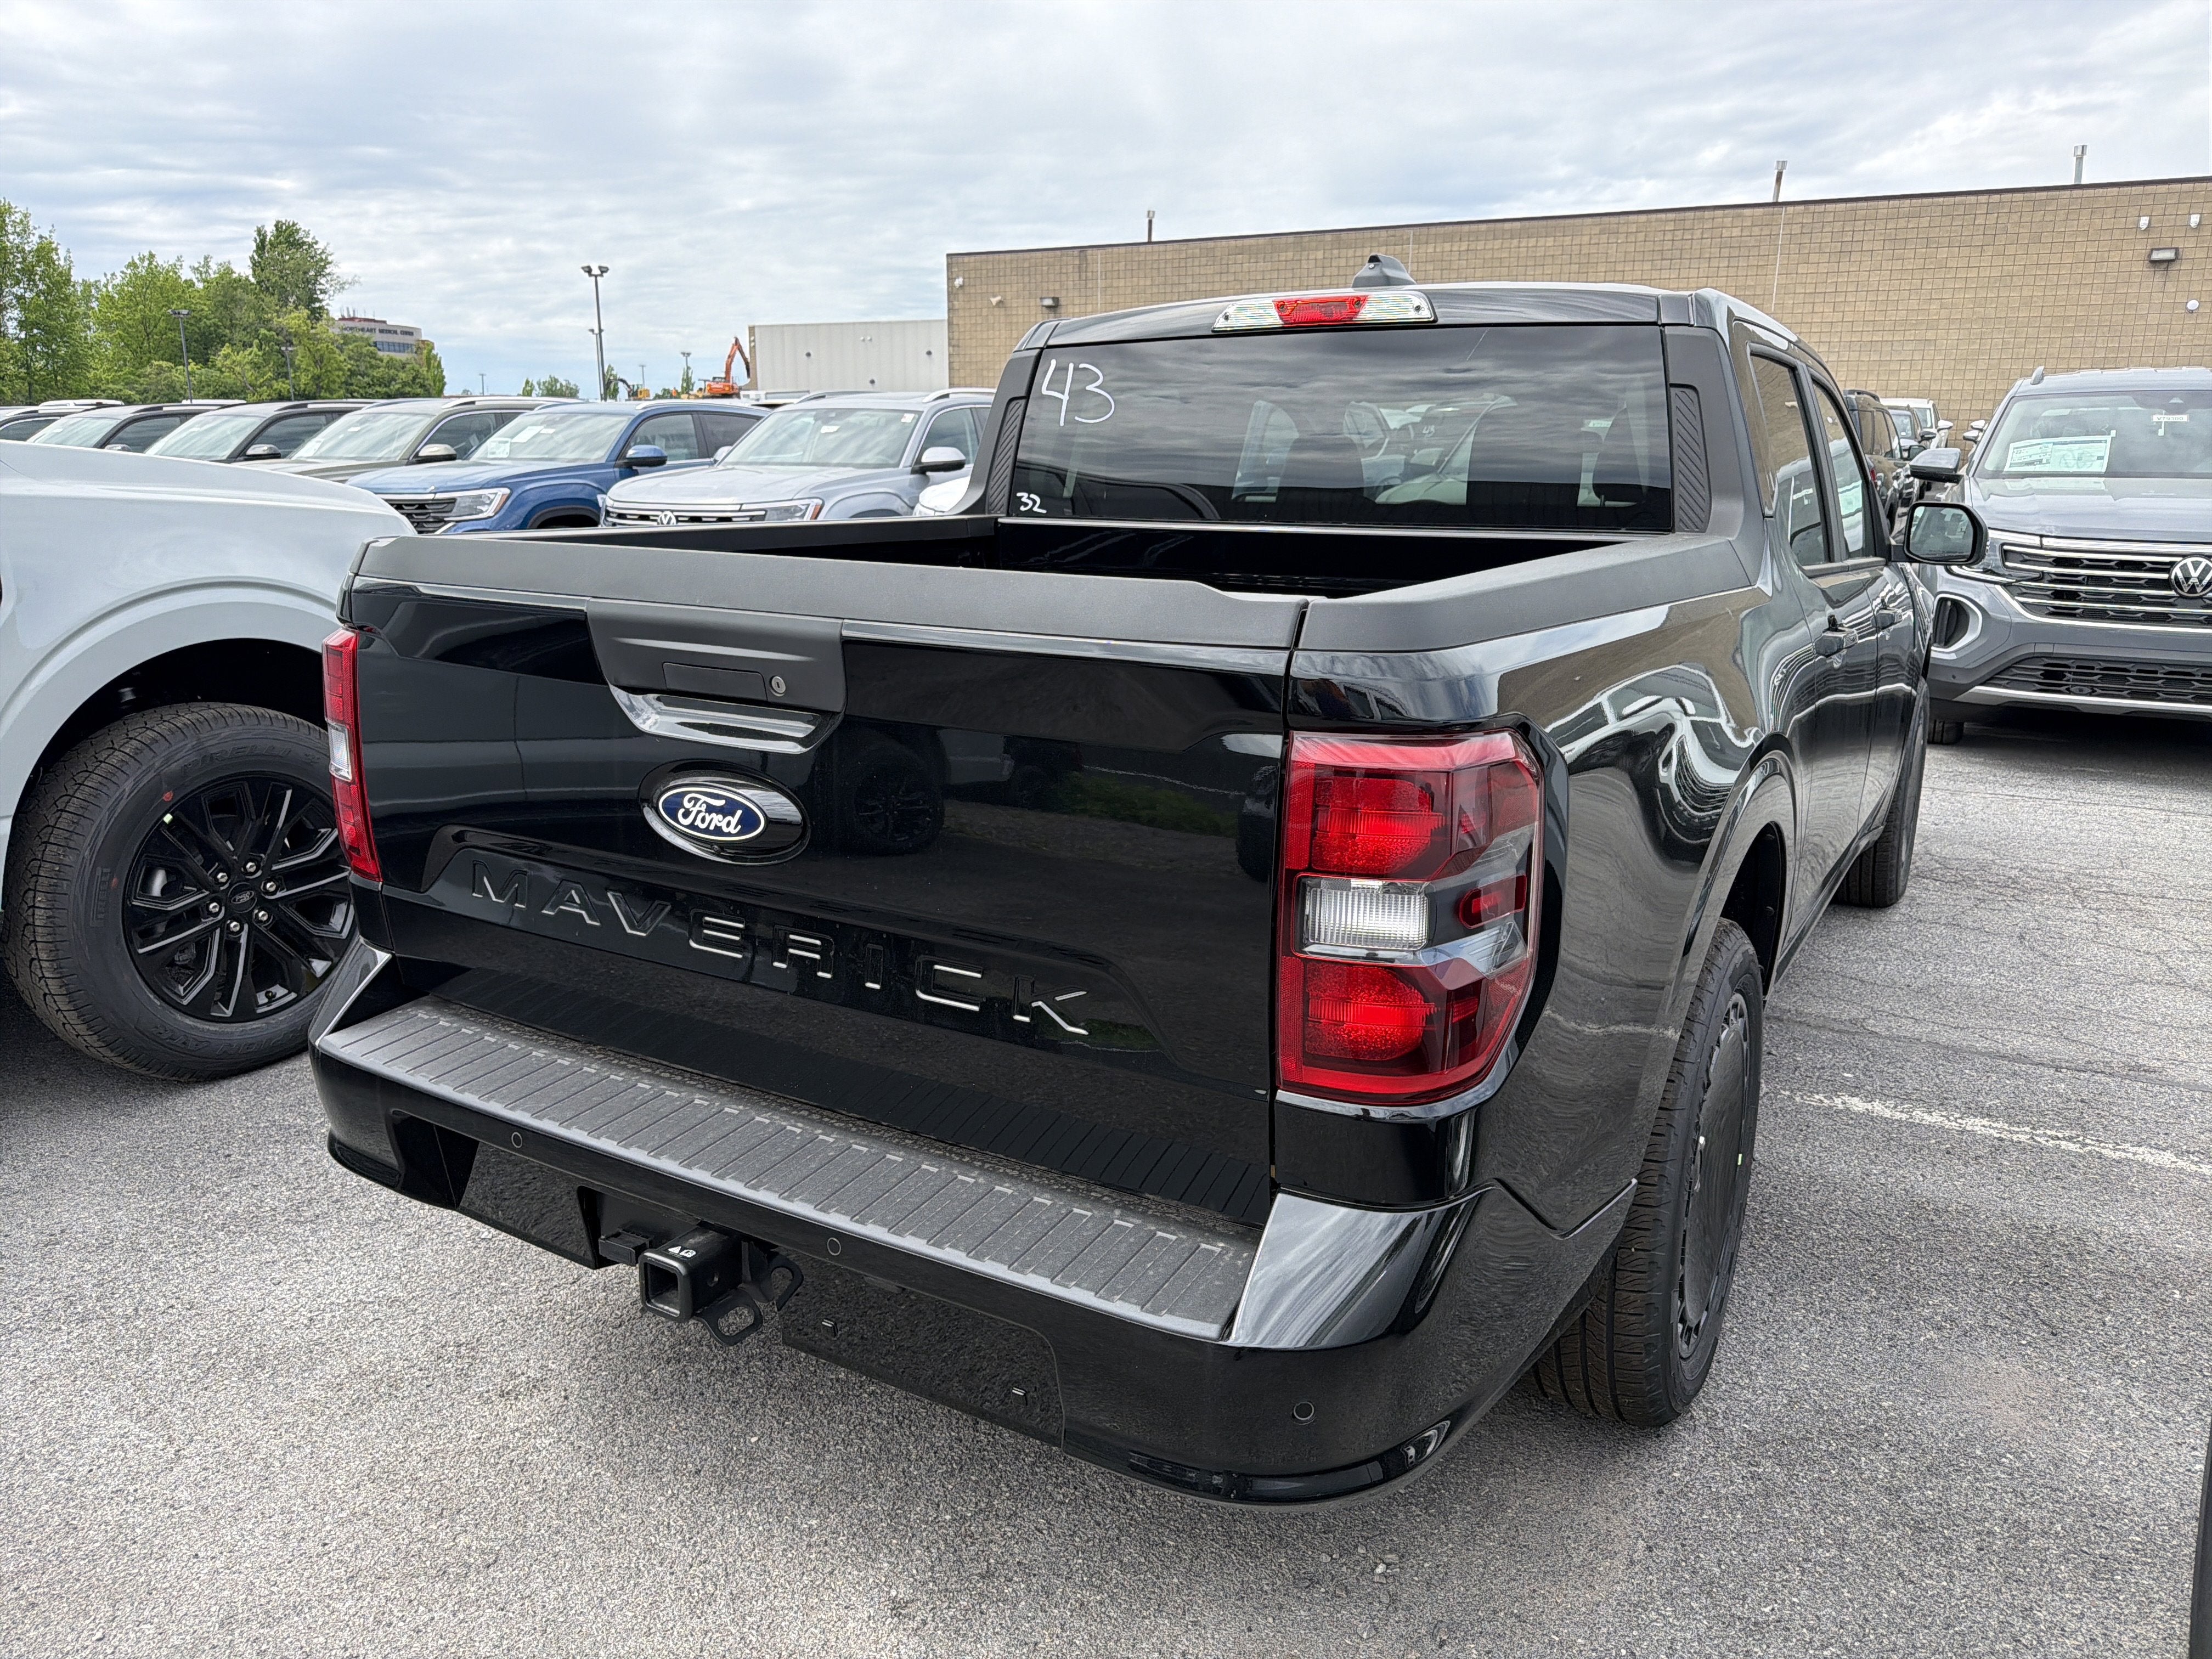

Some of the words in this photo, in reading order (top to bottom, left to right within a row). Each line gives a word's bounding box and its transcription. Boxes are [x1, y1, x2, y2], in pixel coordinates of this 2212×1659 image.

[1042, 359, 1115, 426] 43
[1016, 492, 1047, 514] 32
[678, 793, 743, 834] Ford
[472, 860, 1089, 1035] MAVERICK
